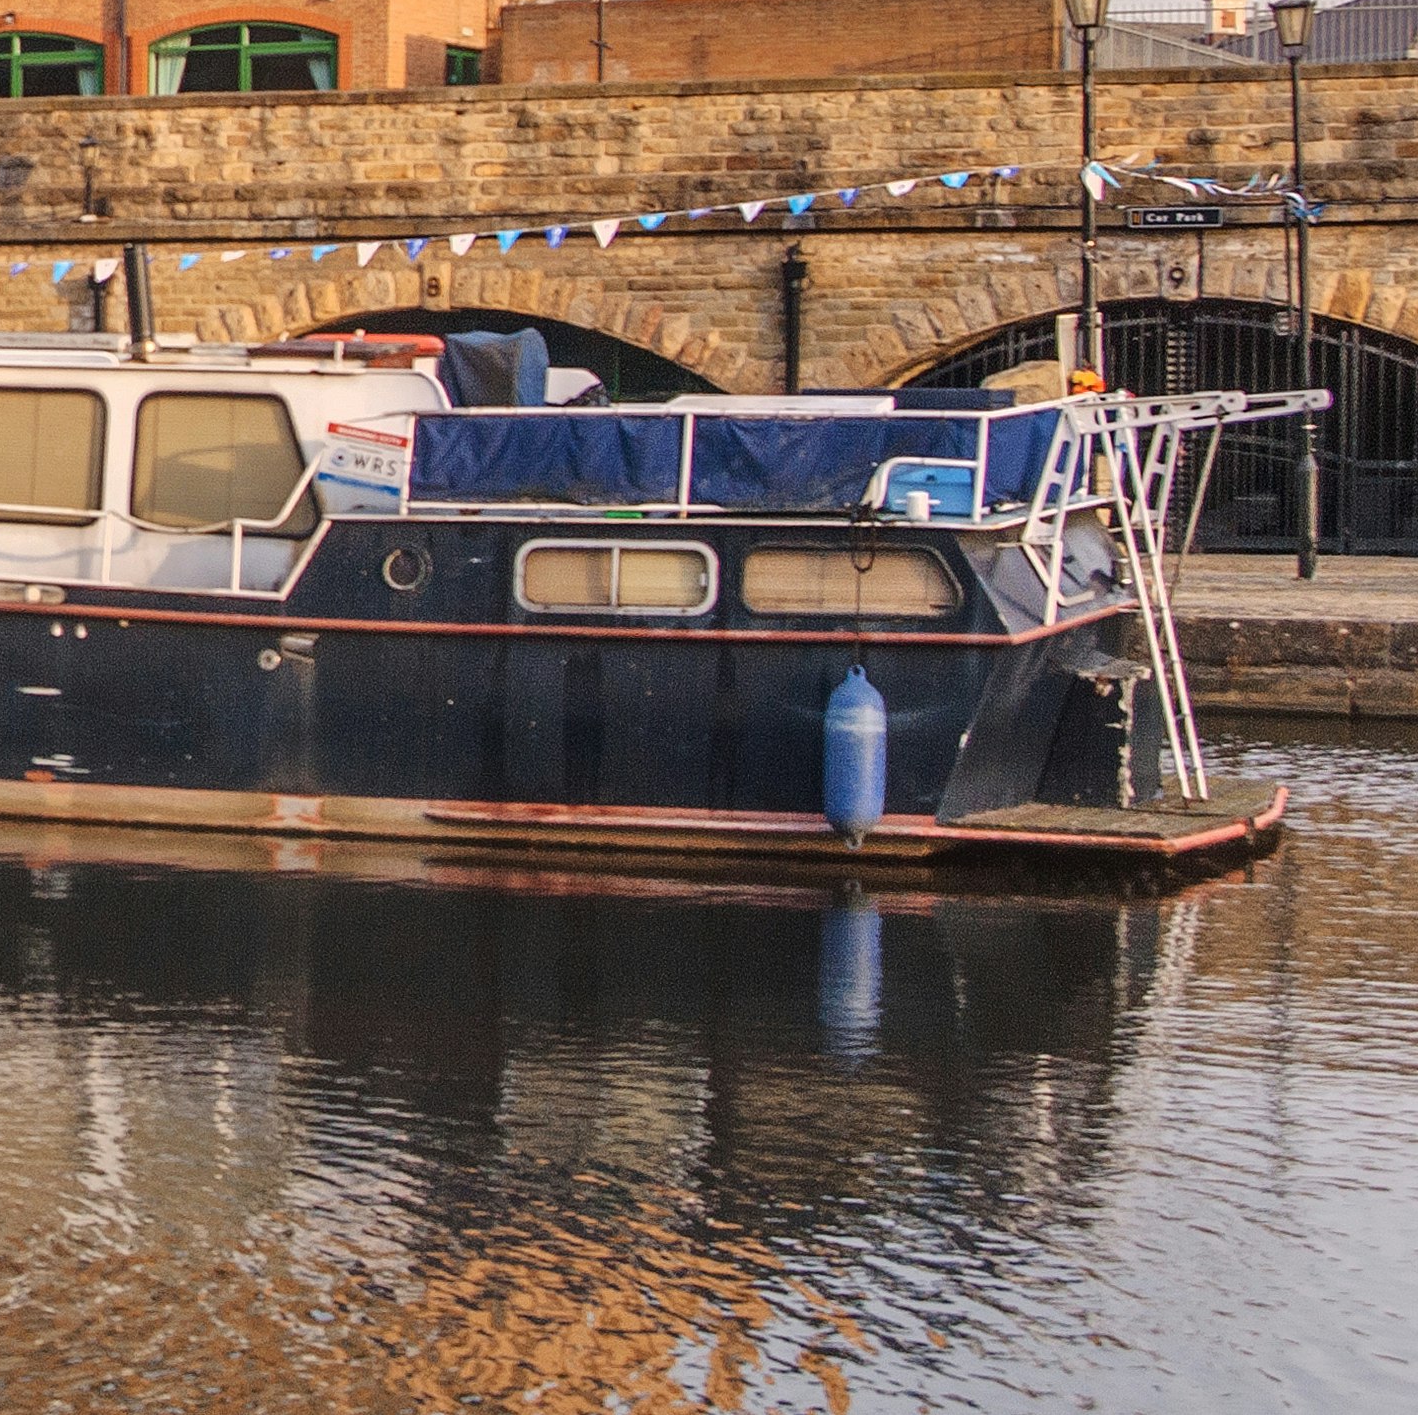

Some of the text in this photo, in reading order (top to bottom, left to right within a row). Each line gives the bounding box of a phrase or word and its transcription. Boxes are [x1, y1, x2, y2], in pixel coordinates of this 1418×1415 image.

[426, 276, 442, 298] 8
[1167, 266, 1185, 290] 9
[353, 453, 398, 477] WRS
